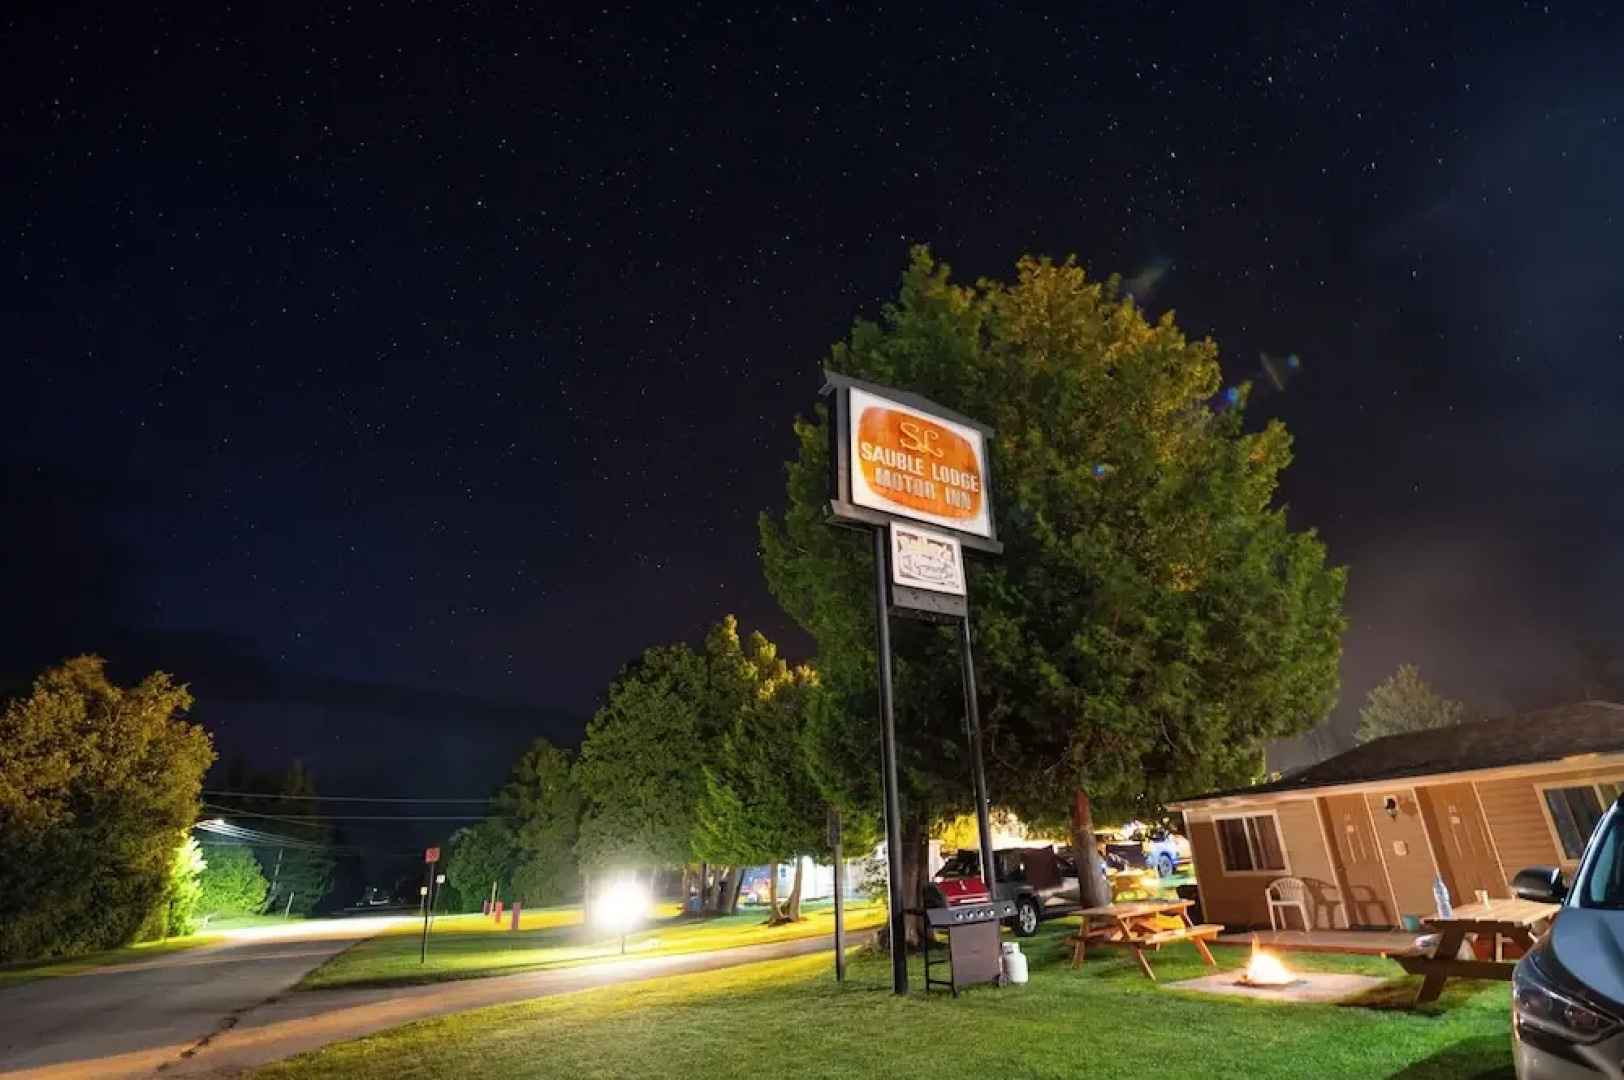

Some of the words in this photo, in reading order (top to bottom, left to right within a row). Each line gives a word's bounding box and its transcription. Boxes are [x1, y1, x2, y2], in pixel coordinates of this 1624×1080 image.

[861, 441, 924, 476] SAUBLE
[931, 462, 979, 493] LODGE
[875, 467, 936, 500] MOTOR
[944, 486, 972, 510] INN
